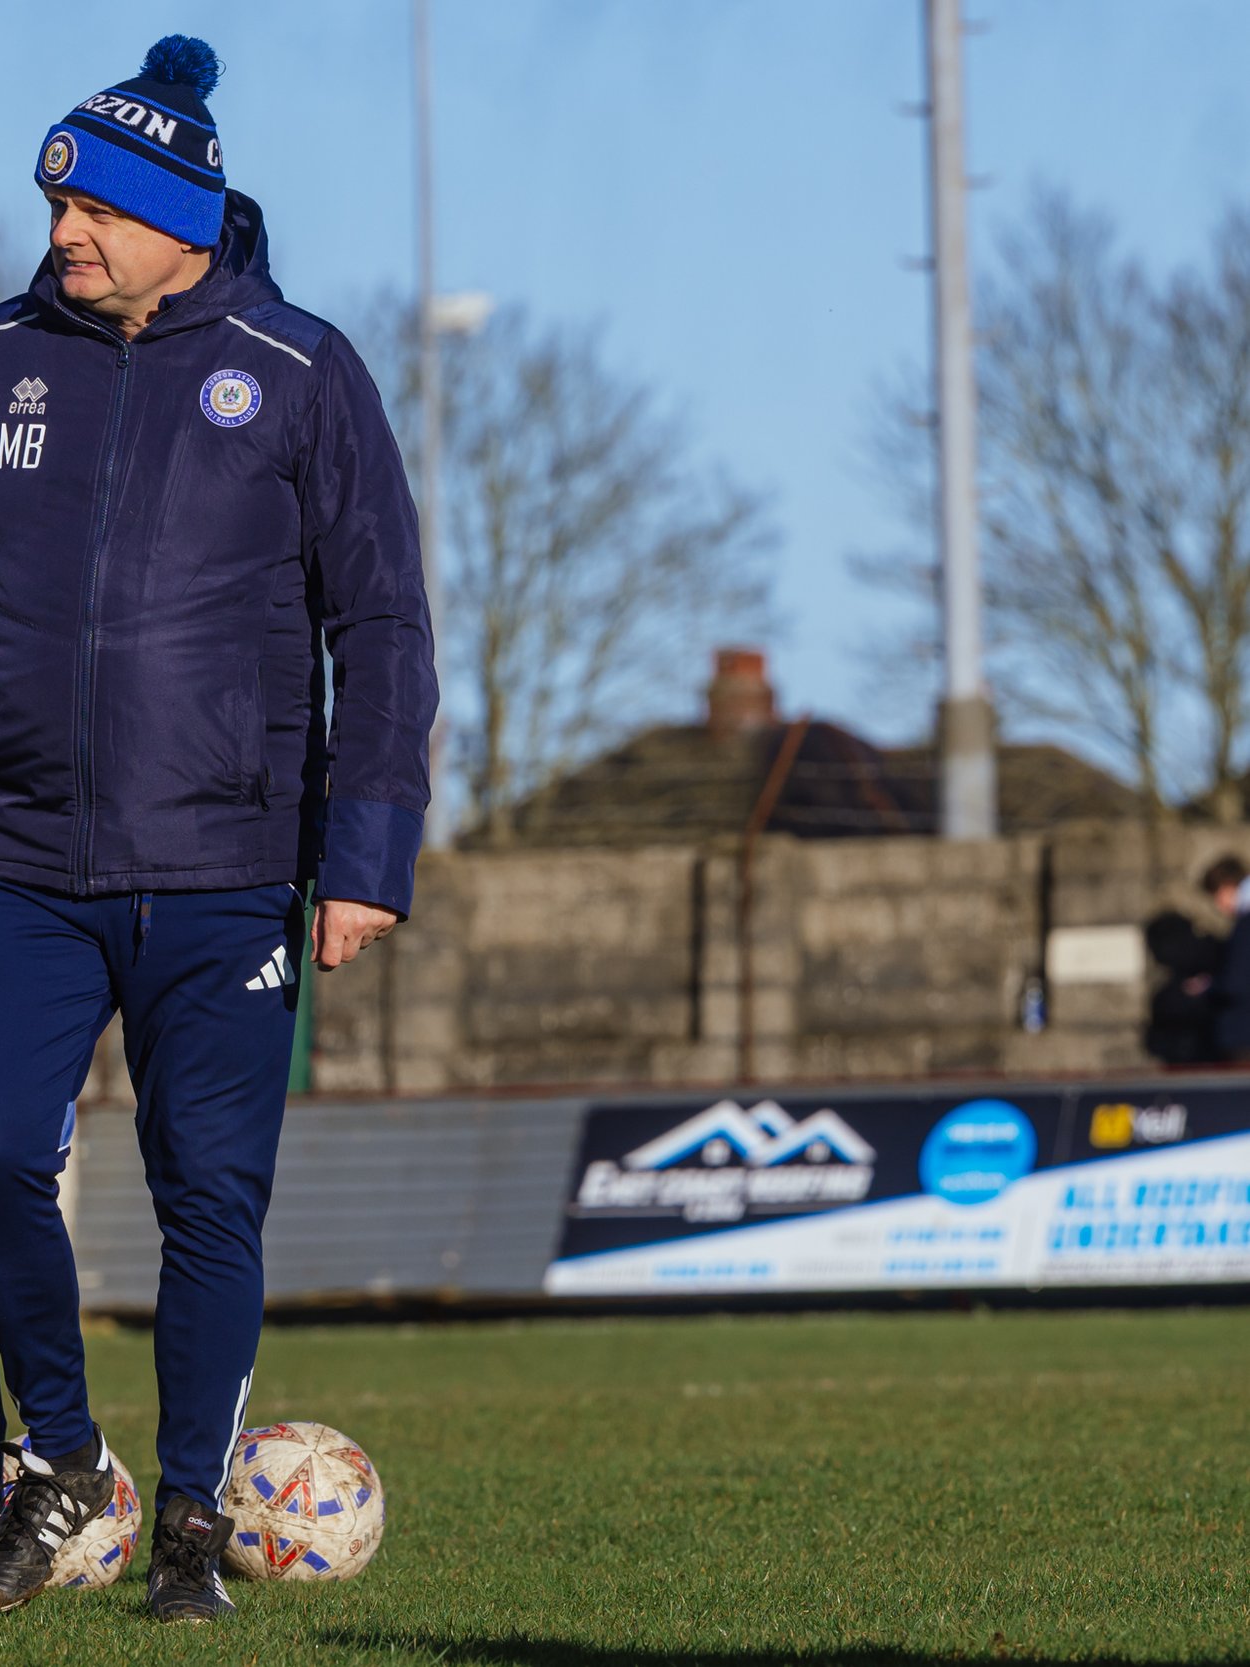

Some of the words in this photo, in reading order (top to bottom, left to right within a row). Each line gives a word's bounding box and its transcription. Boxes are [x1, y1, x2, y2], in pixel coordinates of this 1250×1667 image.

[205, 372, 234, 390] CURZON
[236, 373, 259, 396] ASHTON
[203, 402, 236, 425] FOOTBALL
[238, 406, 256, 422] CLUB
